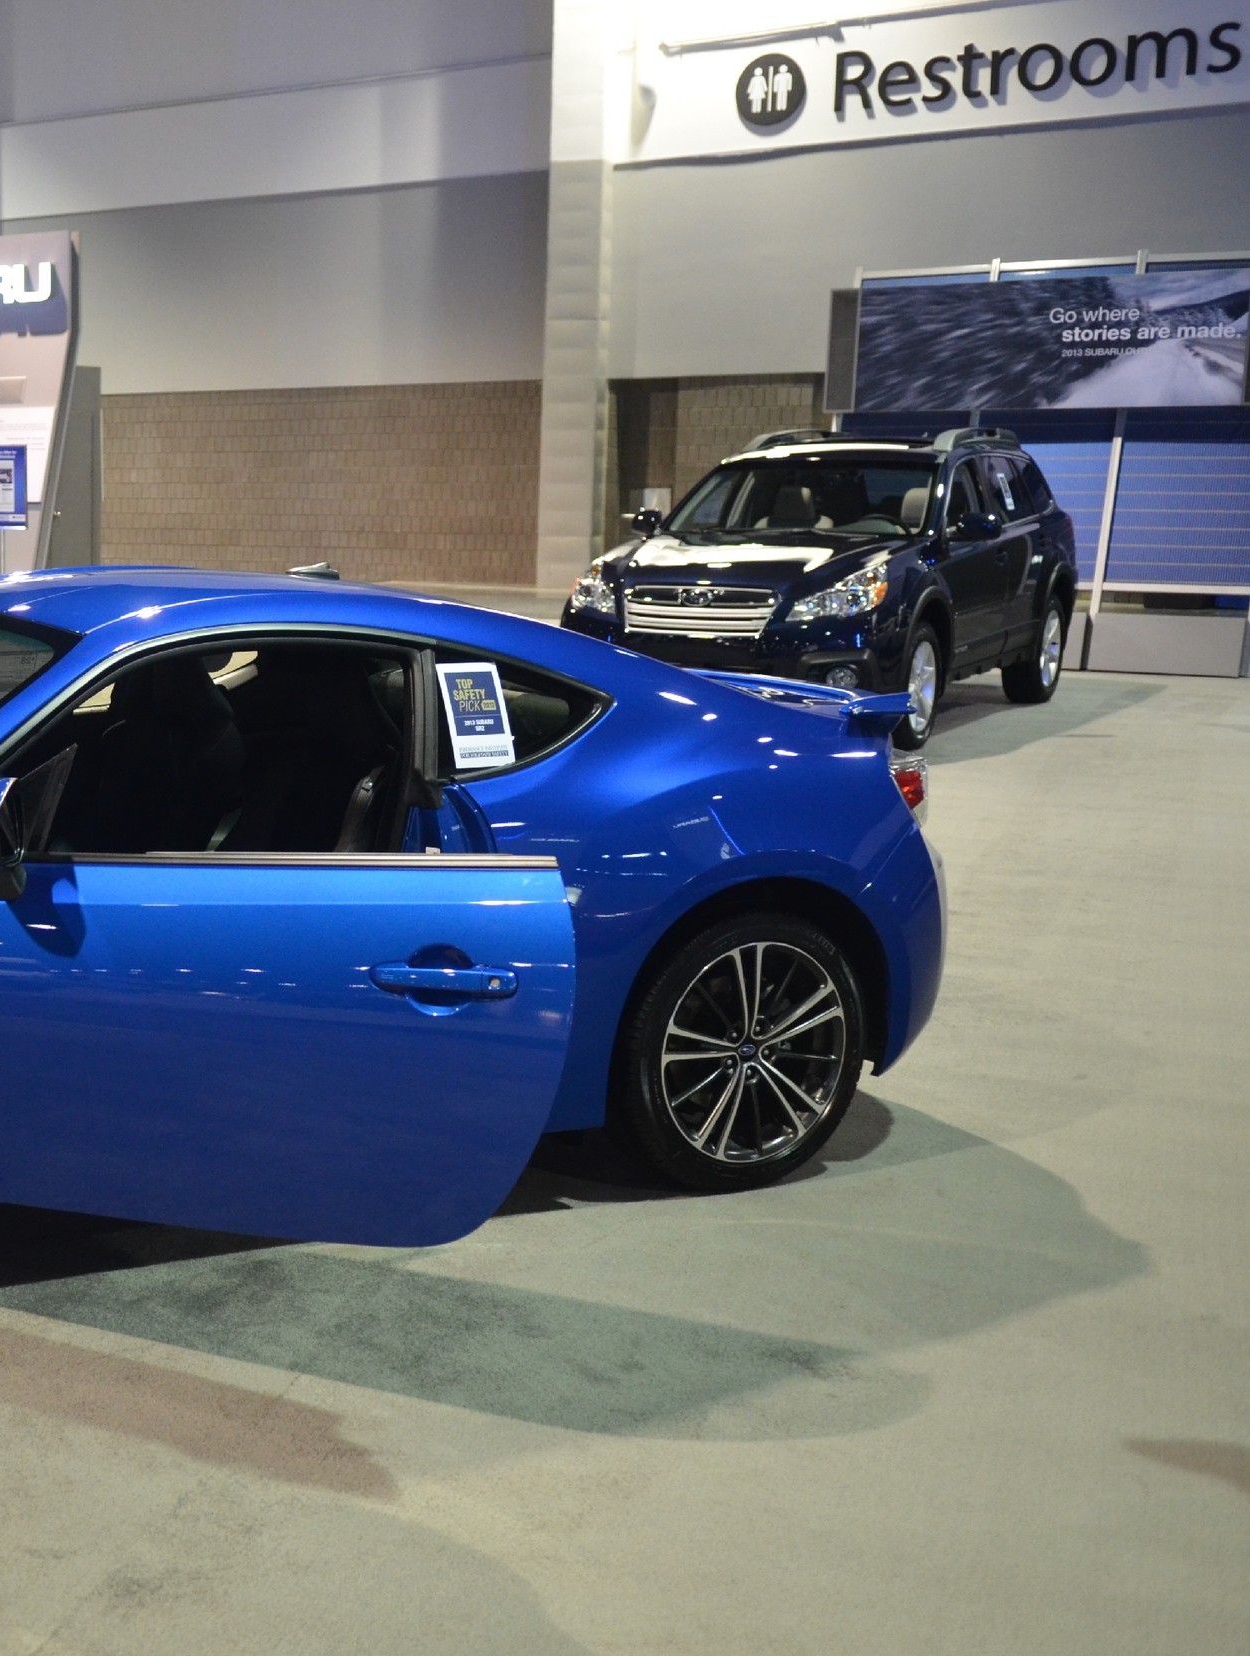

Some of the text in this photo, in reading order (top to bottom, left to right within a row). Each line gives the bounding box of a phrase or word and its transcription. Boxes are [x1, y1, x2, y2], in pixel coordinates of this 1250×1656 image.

[834, 22, 1242, 112] Restrooms
[1049, 306, 1140, 324] Go where
[1062, 322, 1242, 342] stories are made.
[1061, 349, 1083, 357] 2013
[1084, 348, 1123, 357] SUBARU
[455, 678, 473, 689] TOP
[452, 689, 485, 701] SAFETY
[459, 700, 481, 712] PICK
